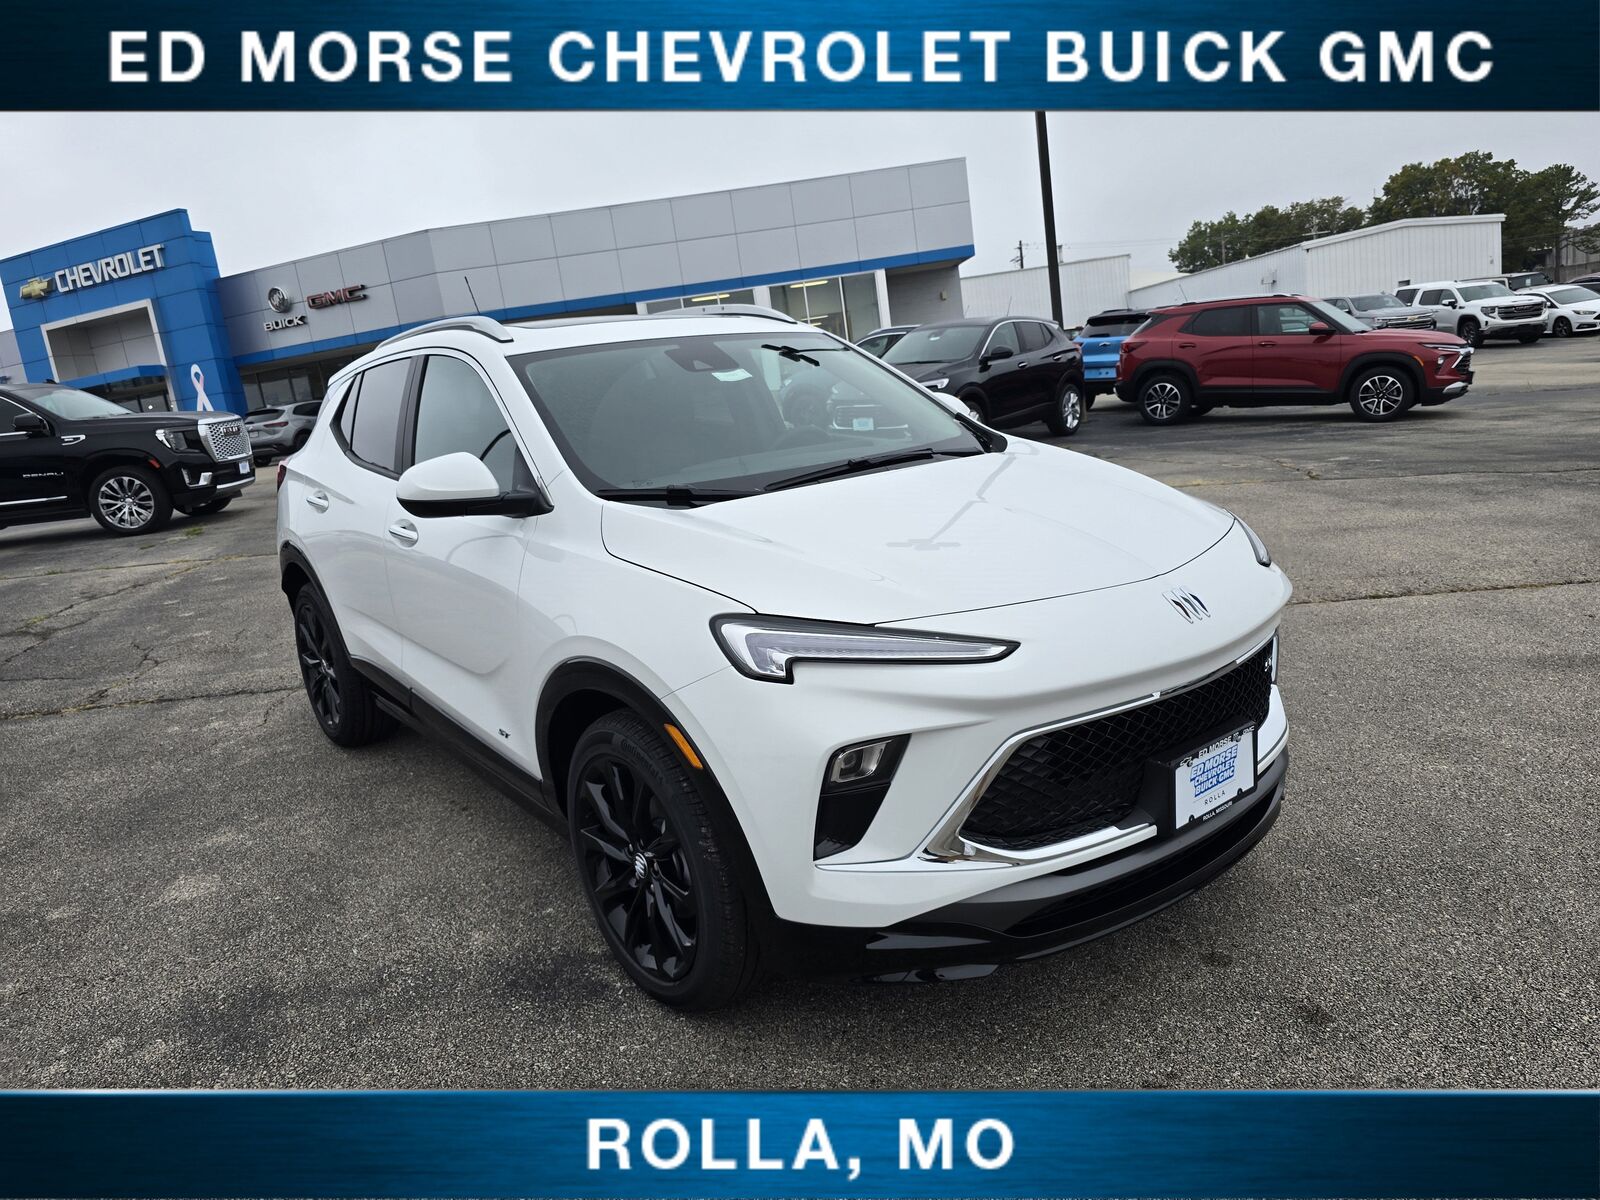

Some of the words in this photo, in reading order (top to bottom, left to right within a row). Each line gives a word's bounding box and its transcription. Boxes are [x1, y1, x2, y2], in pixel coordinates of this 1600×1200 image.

[54, 243, 164, 293] CHEVROLET
[307, 285, 367, 309] GMC
[263, 315, 305, 331] BUICK
[1198, 747, 1208, 758] ED
[1208, 735, 1232, 753] MORSE
[1190, 762, 1205, 781] ED
[1204, 744, 1239, 773] MORSE
[1194, 759, 1236, 787] CHEVROLET
[1194, 776, 1219, 797] BUICK
[1218, 767, 1236, 784] GMC
[1204, 790, 1226, 805] ROLLA
